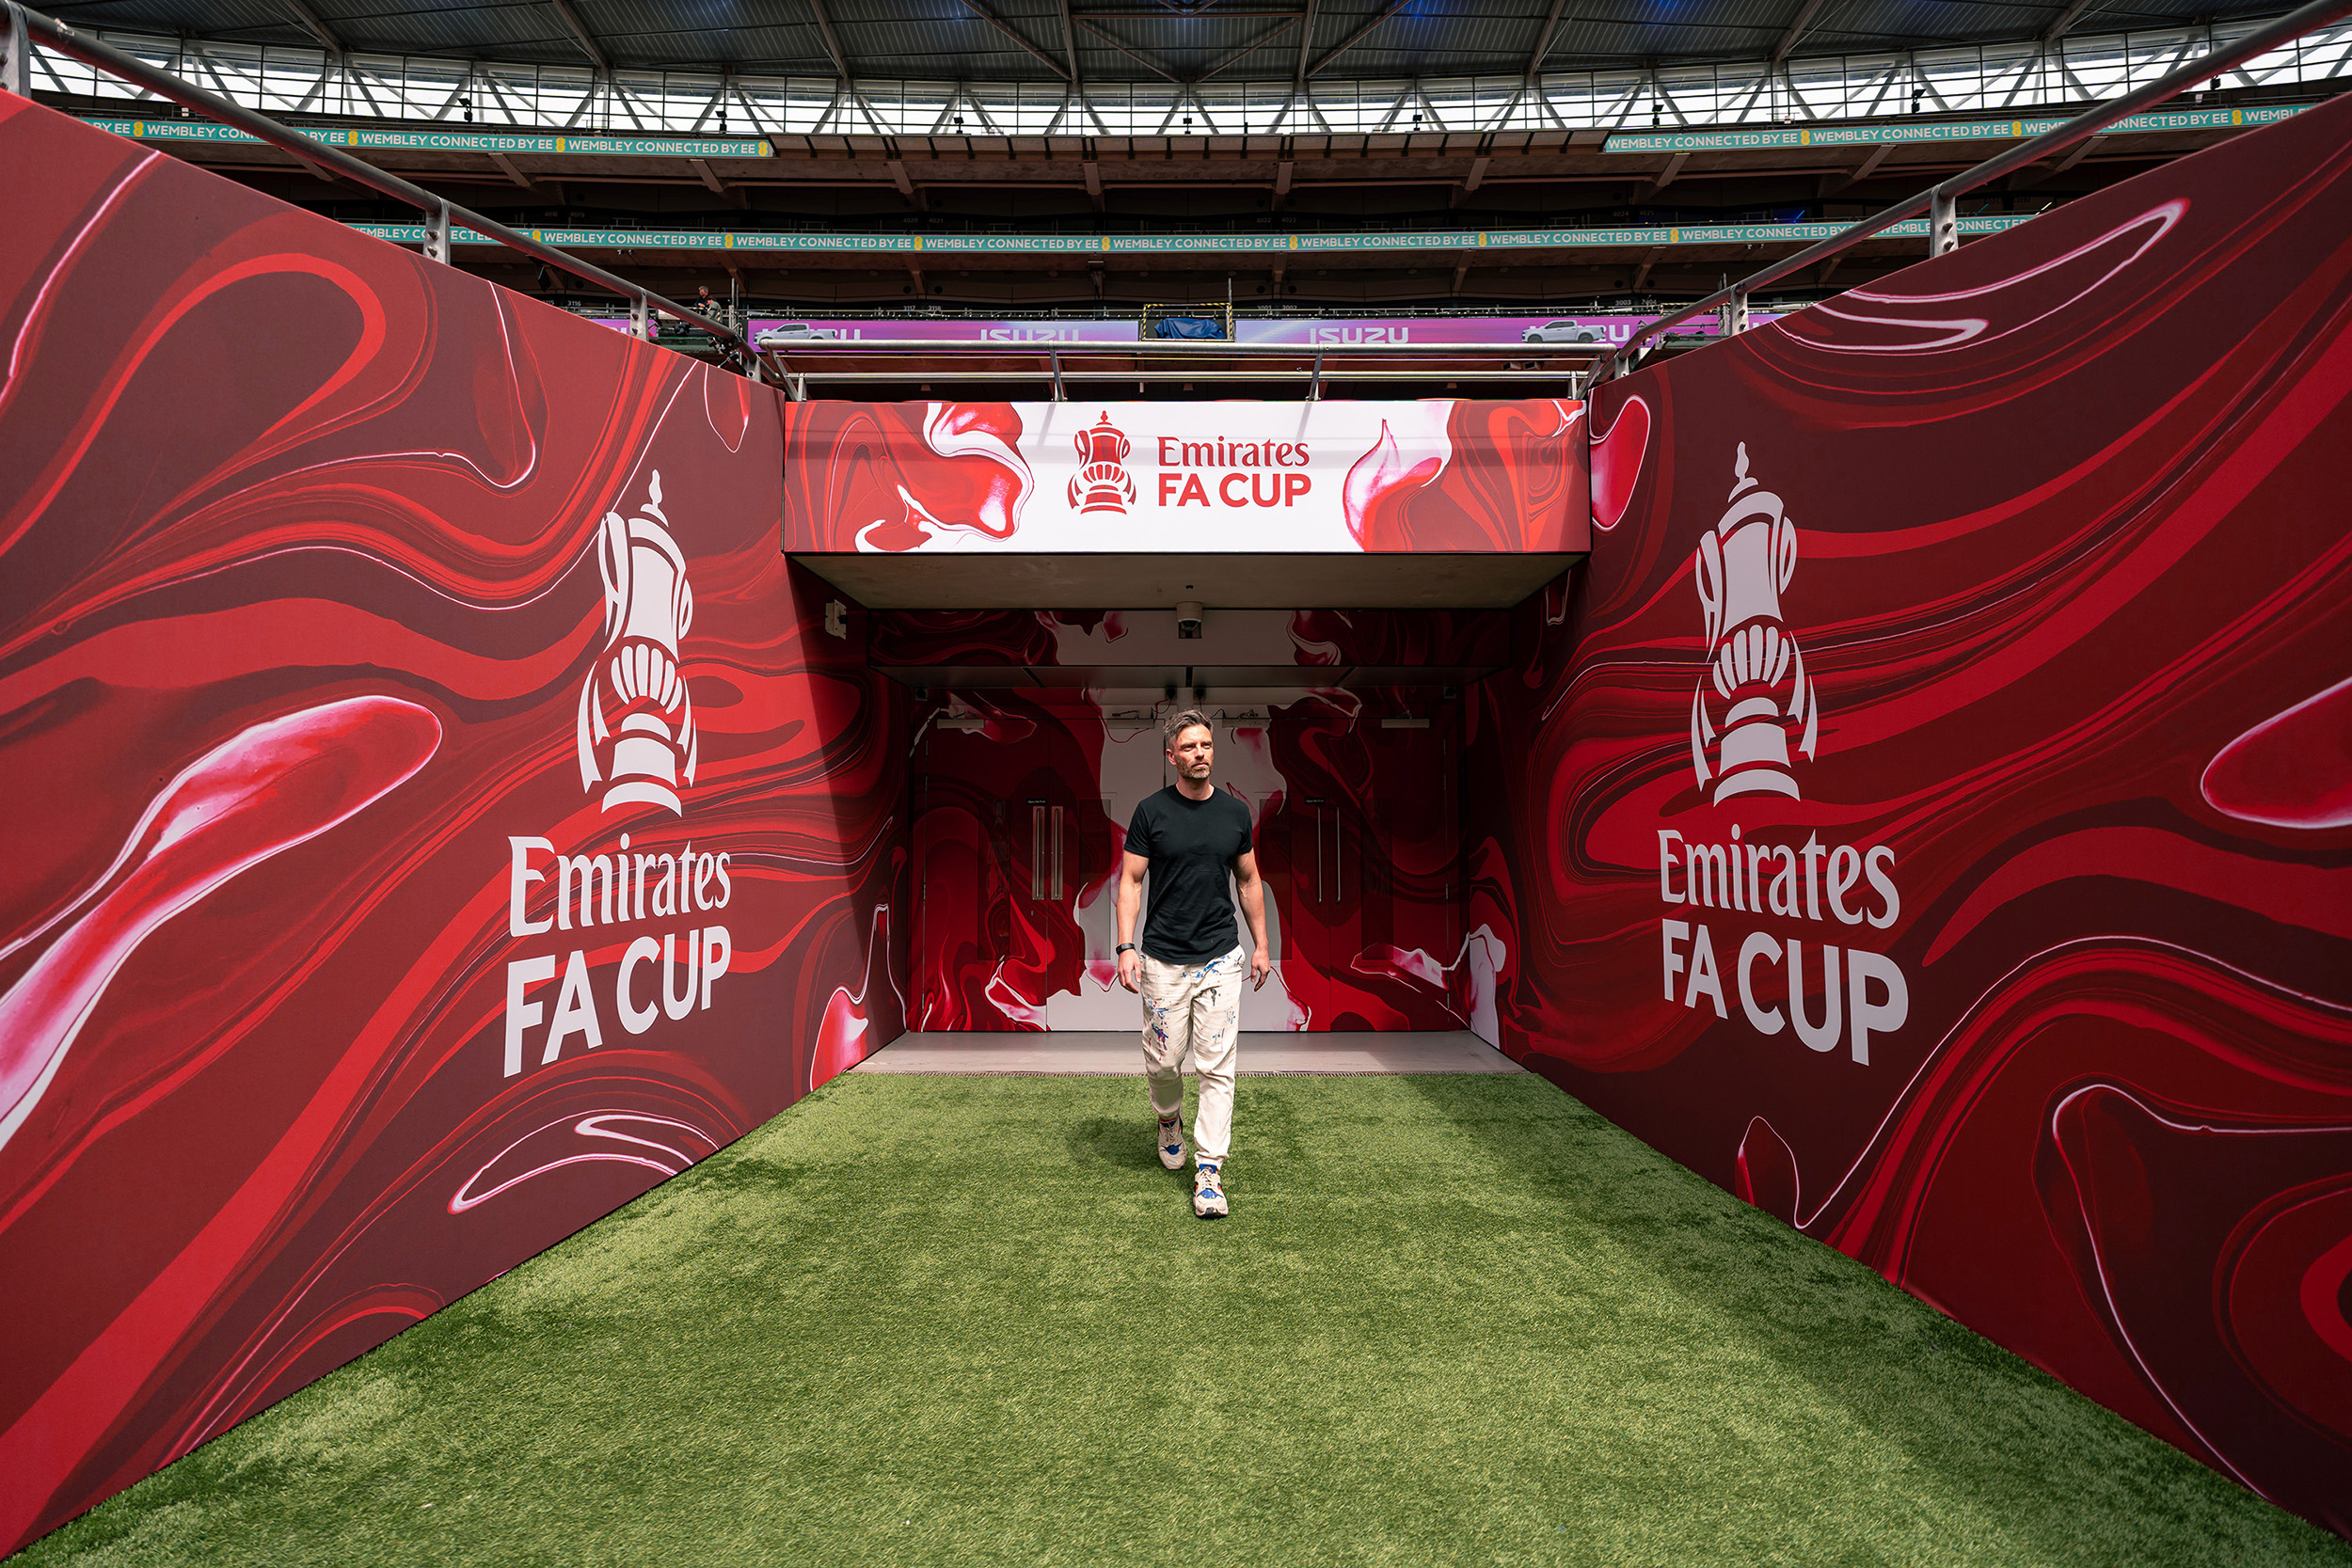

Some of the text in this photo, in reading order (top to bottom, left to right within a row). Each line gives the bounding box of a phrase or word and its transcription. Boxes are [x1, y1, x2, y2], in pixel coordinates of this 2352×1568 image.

[114, 123, 131, 135] EE
[147, 124, 216, 139] WEMBLEY
[329, 132, 345, 143] EE
[361, 133, 428, 146] WEMBLEY
[430, 135, 516, 149] CONNECTED
[517, 138, 536, 150] BY
[537, 138, 553, 150] EE
[568, 139, 633, 151] WEMBLEY
[635, 141, 719, 153] CONNECTED
[721, 143, 739, 154] BY
[740, 143, 755, 154] EE
[1607, 137, 1673, 150] WEMBLEY
[1674, 135, 1760, 148] CONNECTED
[1761, 134, 1780, 145] BY
[1782, 133, 1798, 144] EE
[1813, 129, 1880, 142] WEMBLEY
[1882, 126, 1970, 140] CONNECTED
[1972, 125, 1991, 136] BY
[1993, 124, 2010, 135] EE
[2190, 114, 2210, 125] BY
[2212, 113, 2229, 124] EE
[544, 232, 605, 244] WEMBLEY
[607, 233, 687, 245] CONNECTED
[689, 235, 707, 245] BY
[707, 235, 723, 246] EE
[736, 236, 797, 247] WEMBLEY
[799, 237, 877, 248] CONNECTED
[879, 238, 896, 248] BY
[897, 238, 912, 248] EE
[925, 238, 985, 248] WEMBLEY
[987, 238, 1065, 249] CONNECTED
[1067, 239, 1083, 249] BY
[1085, 239, 1099, 249] EE
[1113, 238, 1173, 248] WEMBLEY
[1174, 238, 1252, 248] CONNECTED
[1254, 238, 1271, 248] BY
[1272, 238, 1287, 248] EE
[1300, 237, 1360, 247] WEMBLEY
[1362, 235, 1441, 246] CONNECTED
[1442, 235, 1459, 245] BY
[1461, 235, 1476, 245] EE
[1489, 233, 1550, 245] WEMBLEY
[1552, 231, 1632, 244] CONNECTED
[1634, 231, 1651, 242] BY
[1653, 230, 1668, 242] EE
[1681, 229, 1744, 241] WEMBLEY
[1746, 227, 1828, 238] CONNECTED
[980, 328, 1079, 341] ISUZU
[1309, 326, 1409, 344] ISUZU
[1156, 435, 1311, 467] Emirates
[1158, 472, 1312, 508] FA CUP
[507, 832, 732, 938] Emirates
[1657, 823, 1900, 929] Emirates
[503, 925, 732, 1079] FA CUP
[1661, 918, 1910, 1067] FA CUP
